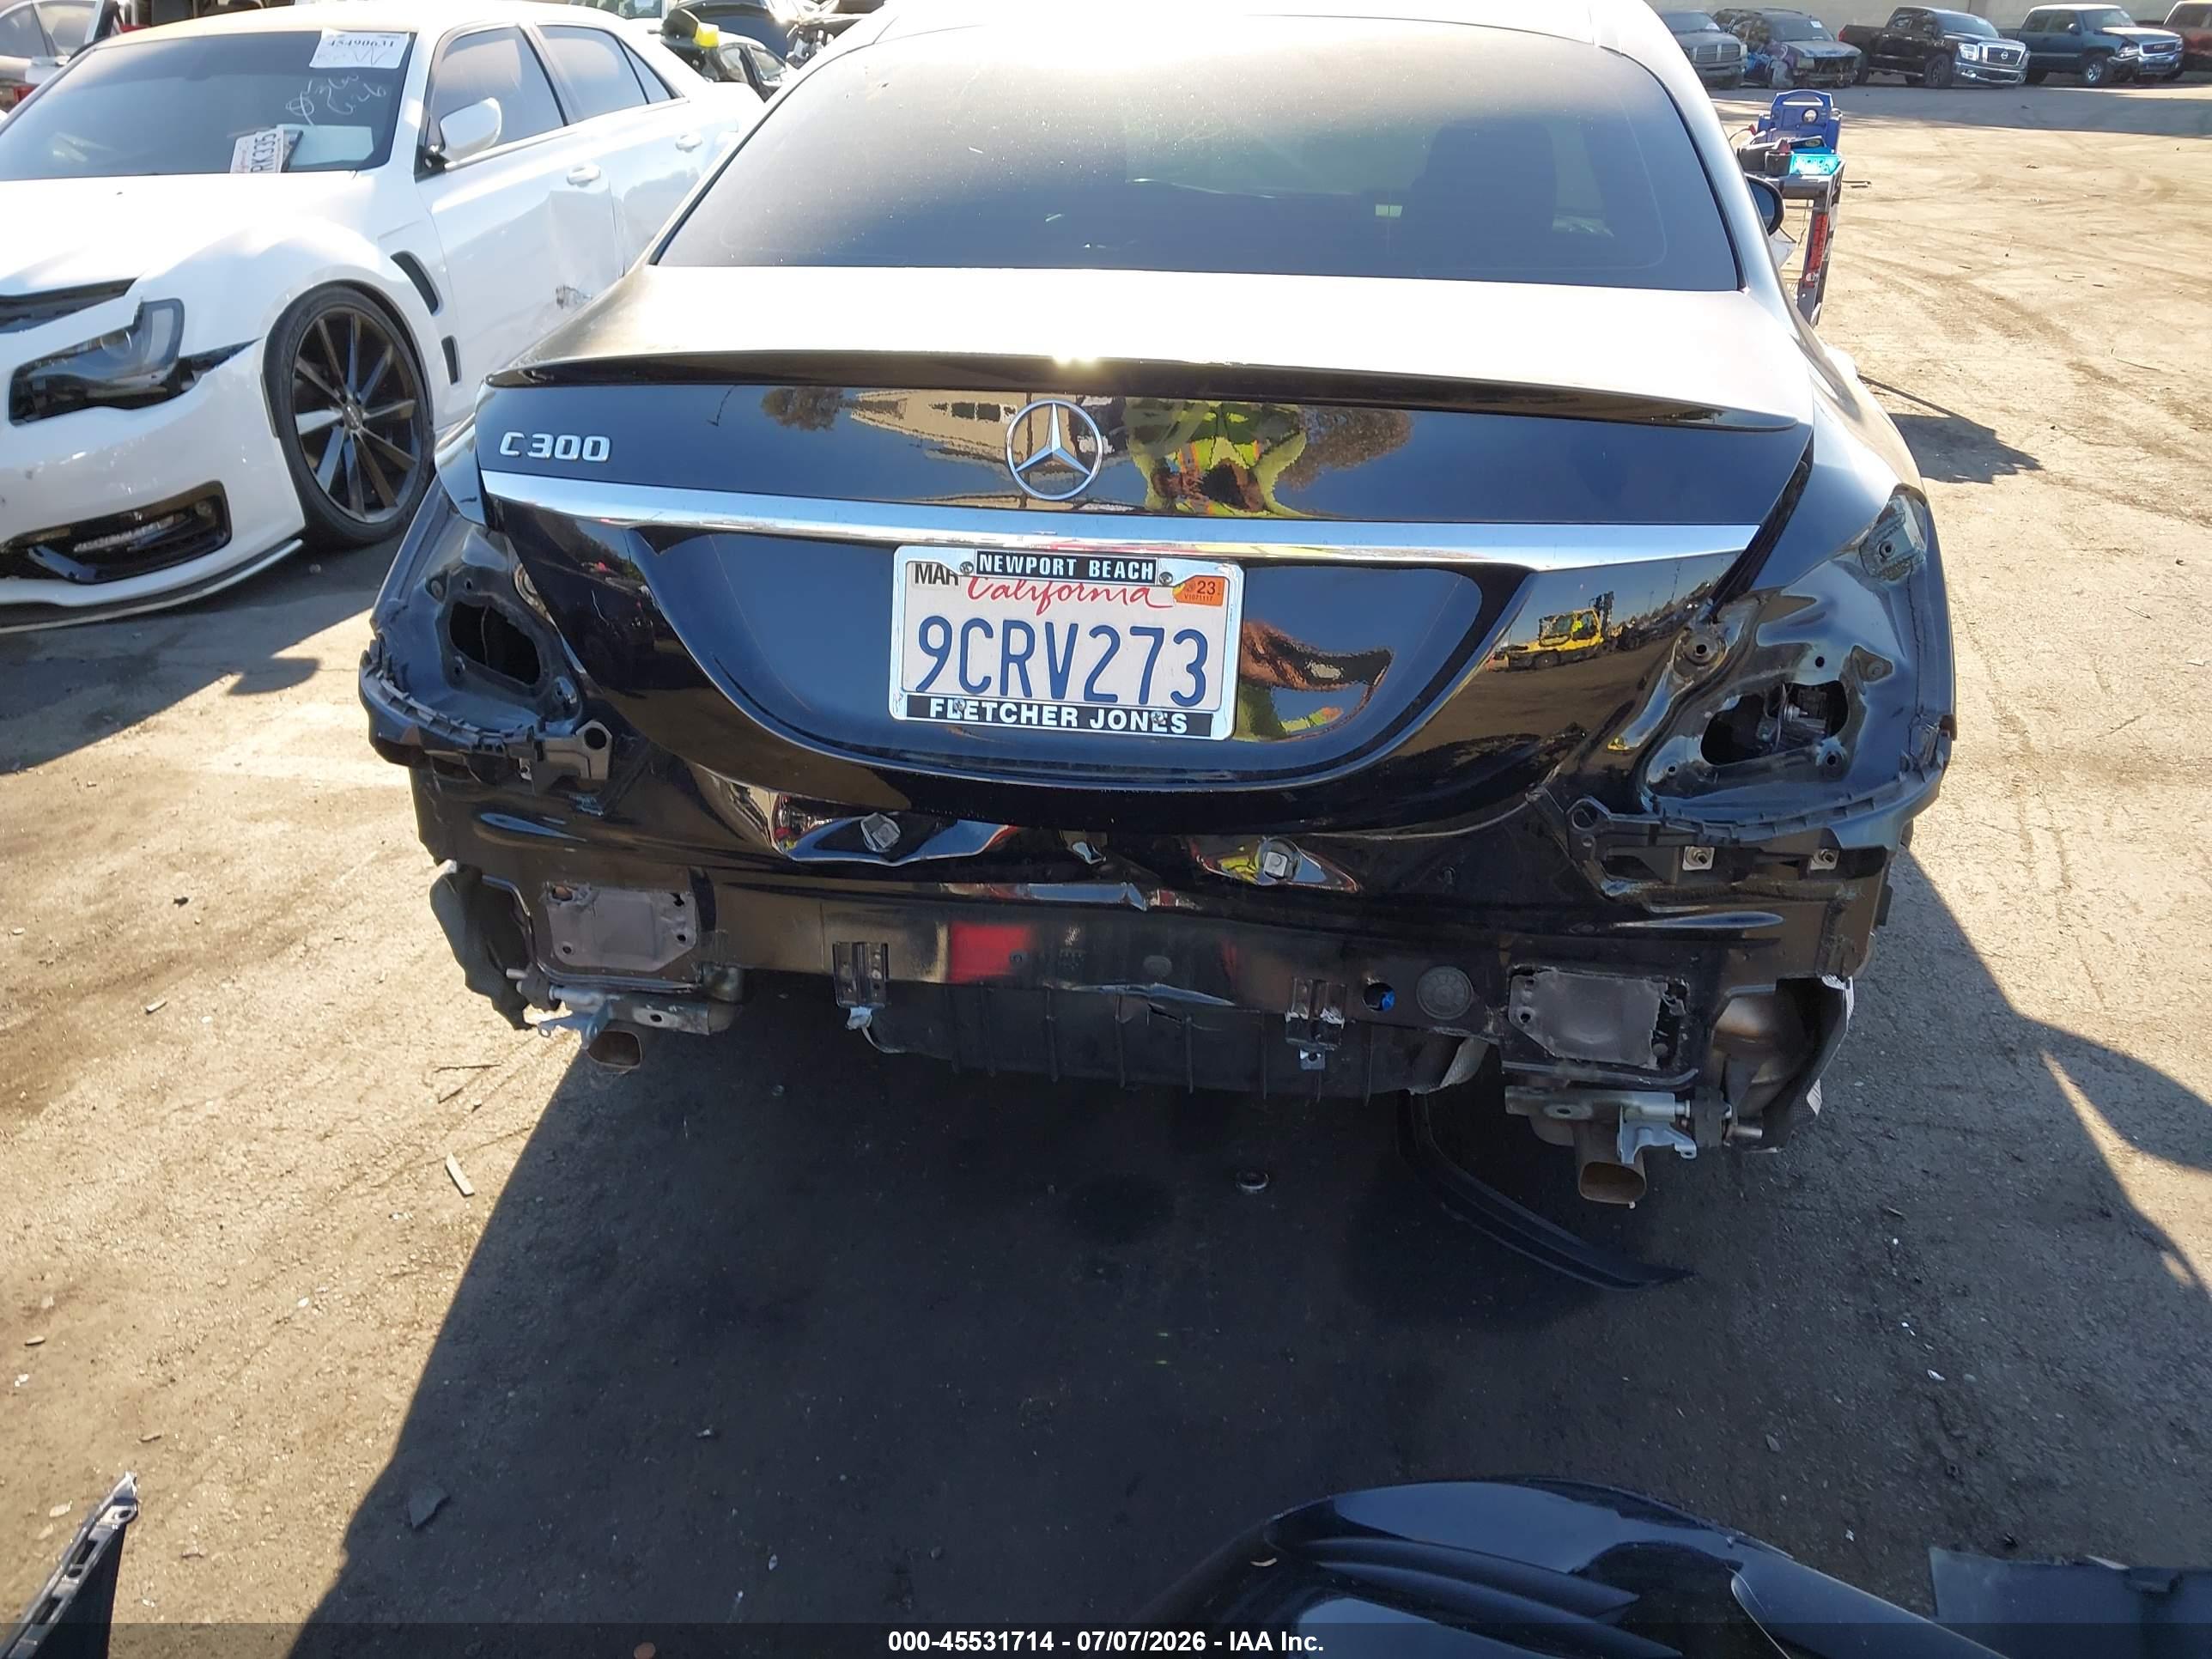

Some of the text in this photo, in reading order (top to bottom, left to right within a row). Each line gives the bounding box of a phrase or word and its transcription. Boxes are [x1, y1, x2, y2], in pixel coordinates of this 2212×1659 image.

[979, 553, 1153, 580] NEWPORT BEACH
[968, 576, 1174, 617] California
[1196, 580, 1216, 595] 23
[915, 615, 1208, 707] 9CRV273
[929, 697, 1079, 727] FLETCHER
